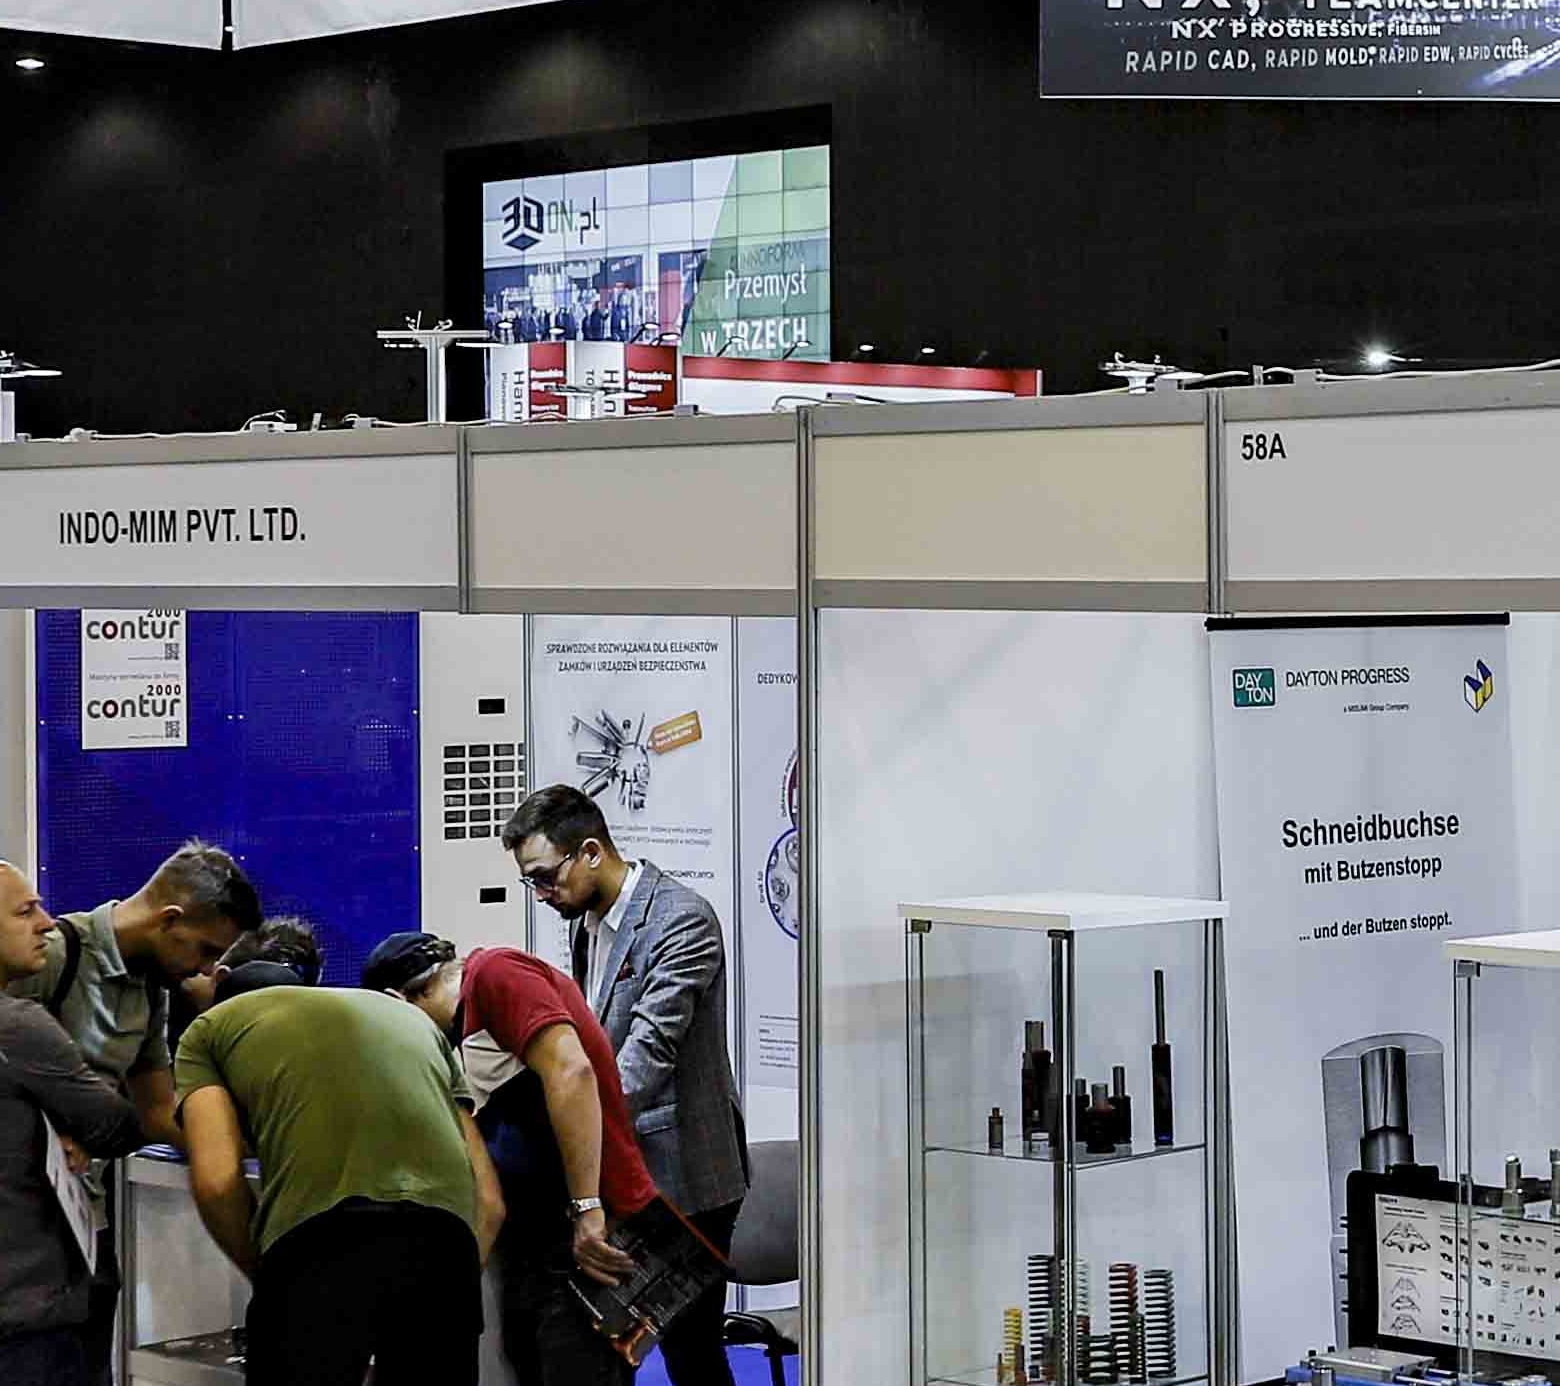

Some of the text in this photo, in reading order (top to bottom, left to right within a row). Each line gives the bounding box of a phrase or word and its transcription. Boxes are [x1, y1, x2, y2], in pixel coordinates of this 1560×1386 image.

[1171, 20, 1218, 39] NX
[1124, 49, 1198, 74] RAPID
[1207, 48, 1257, 71] CAD,
[1265, 48, 1319, 68] RAPID
[1379, 45, 1419, 64] RAPID
[1458, 44, 1491, 61] RAPID
[724, 263, 808, 304] Przemysł
[721, 316, 808, 353] TRZECH
[1240, 432, 1287, 461] 58A
[58, 506, 307, 545] INDO-MIM PVT. LTD.
[86, 615, 182, 640] contur
[146, 684, 182, 696] 2000
[1235, 671, 1263, 690] DAY
[1285, 666, 1411, 688] DAYTON PROGRESS
[86, 694, 182, 719] contur
[1246, 686, 1273, 703] TON
[1281, 809, 1461, 848] Schneidbuchse
[1303, 855, 1443, 885] mit Butzenstopp
[1313, 910, 1453, 940] und der Butzen stoppt.
